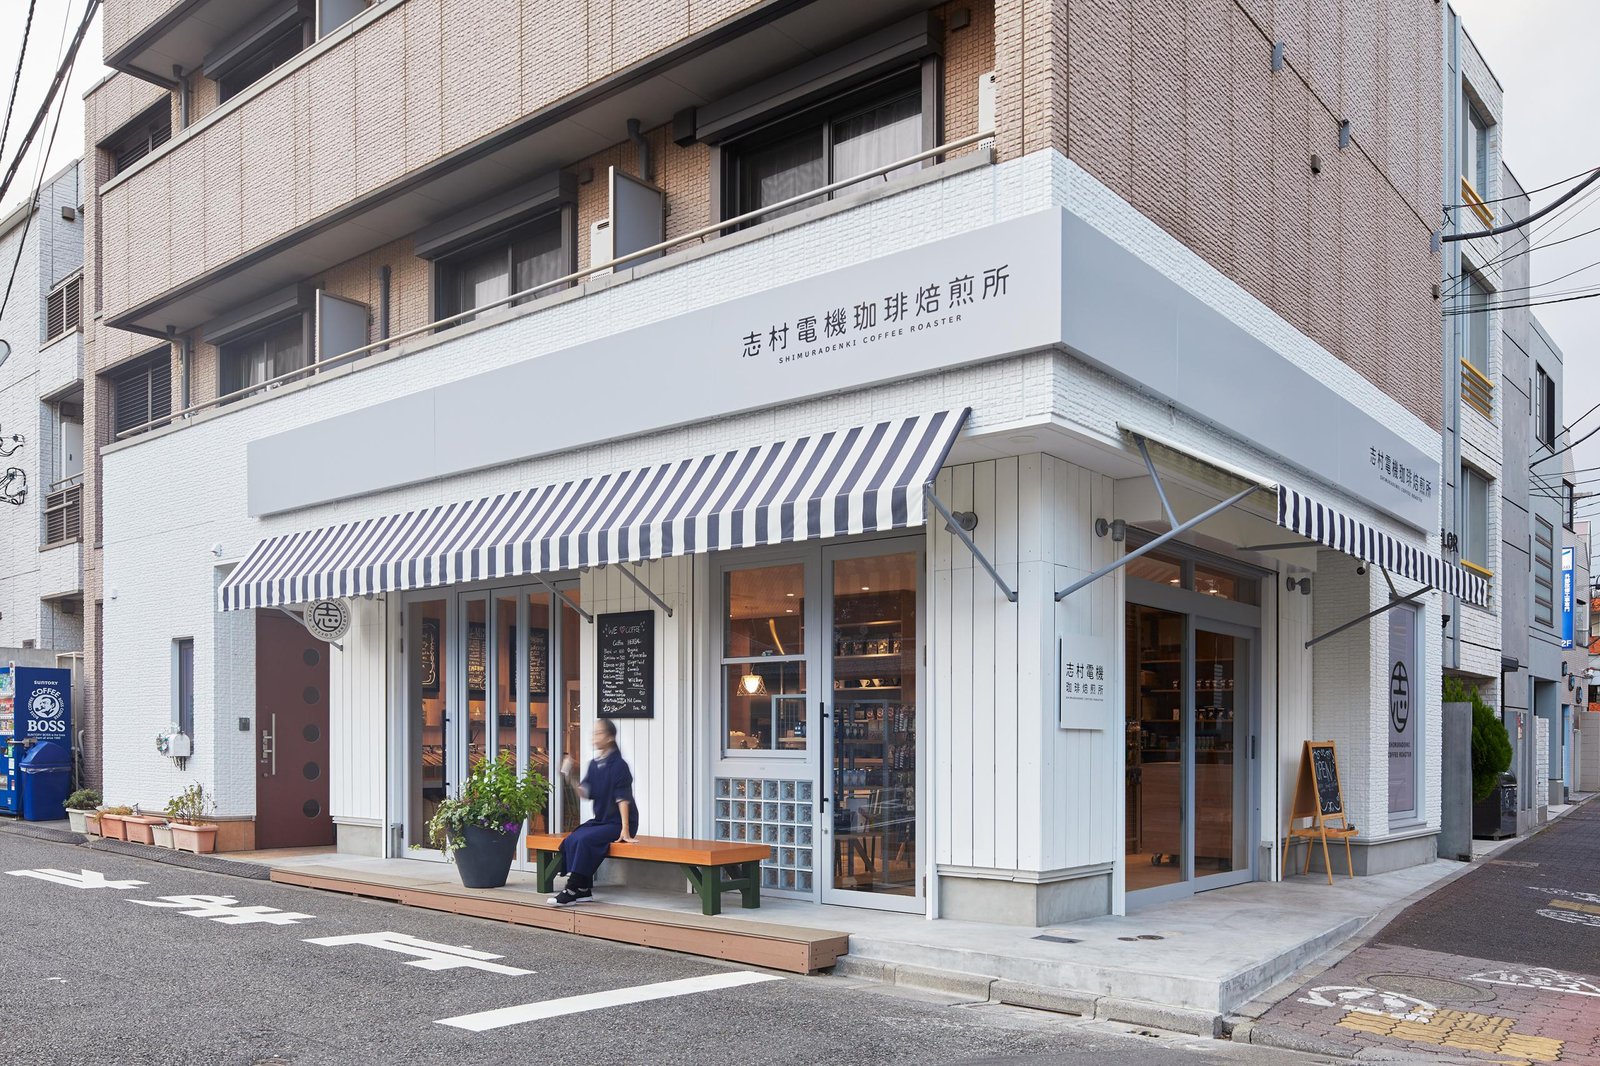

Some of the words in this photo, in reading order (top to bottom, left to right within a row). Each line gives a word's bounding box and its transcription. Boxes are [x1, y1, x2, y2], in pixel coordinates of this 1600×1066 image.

[742, 264, 1010, 358] 志村電機珈琲焙煎所
[778, 339, 857, 364] SHIMURADENKI
[863, 328, 904, 344] COFFEE
[910, 314, 963, 333] ROASTER
[1066, 662, 1104, 681] 志村電機
[32, 688, 61, 698] COFFEE
[27, 720, 65, 732] BOSS
